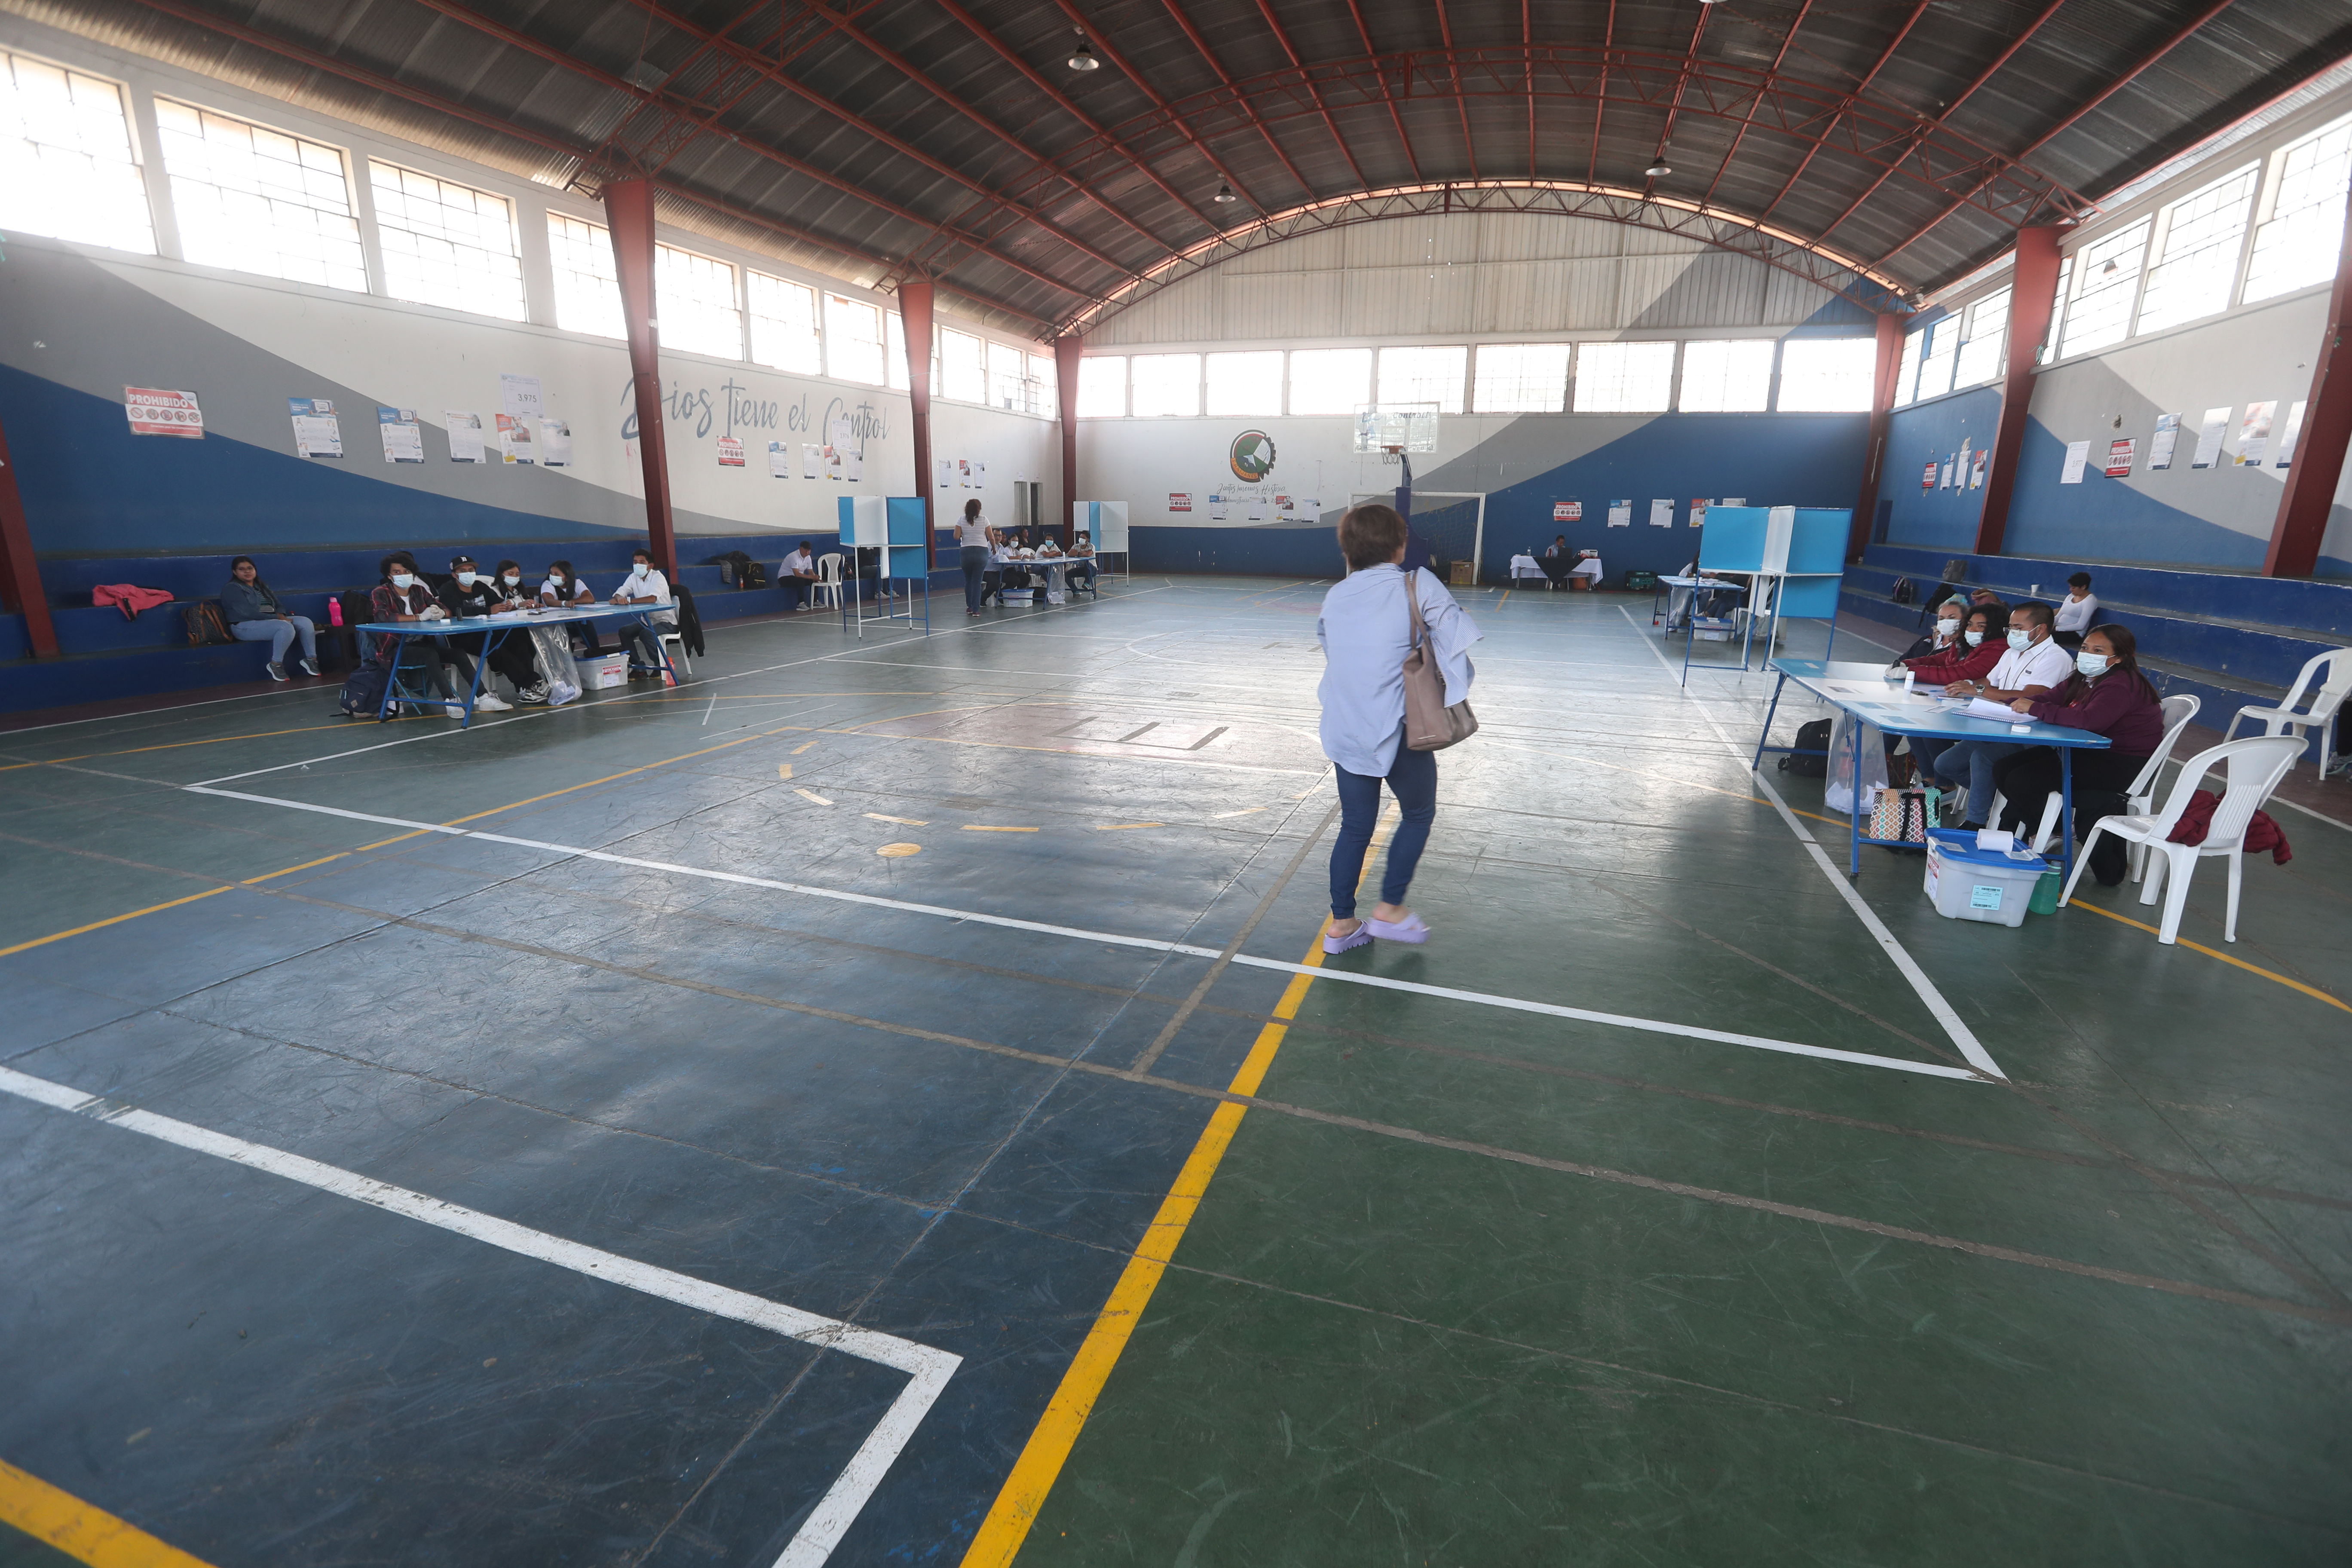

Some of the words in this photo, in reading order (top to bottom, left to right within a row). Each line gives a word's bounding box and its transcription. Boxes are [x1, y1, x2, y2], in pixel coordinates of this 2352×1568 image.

[129, 394, 188, 408] PROHIBIDO
[788, 393, 811, 432] el
[1232, 459, 1257, 478] FRAIJANES
[1217, 483, 1236, 494] Juntos
[1237, 484, 1259, 494] haremos
[1261, 483, 1286, 496] Historia
